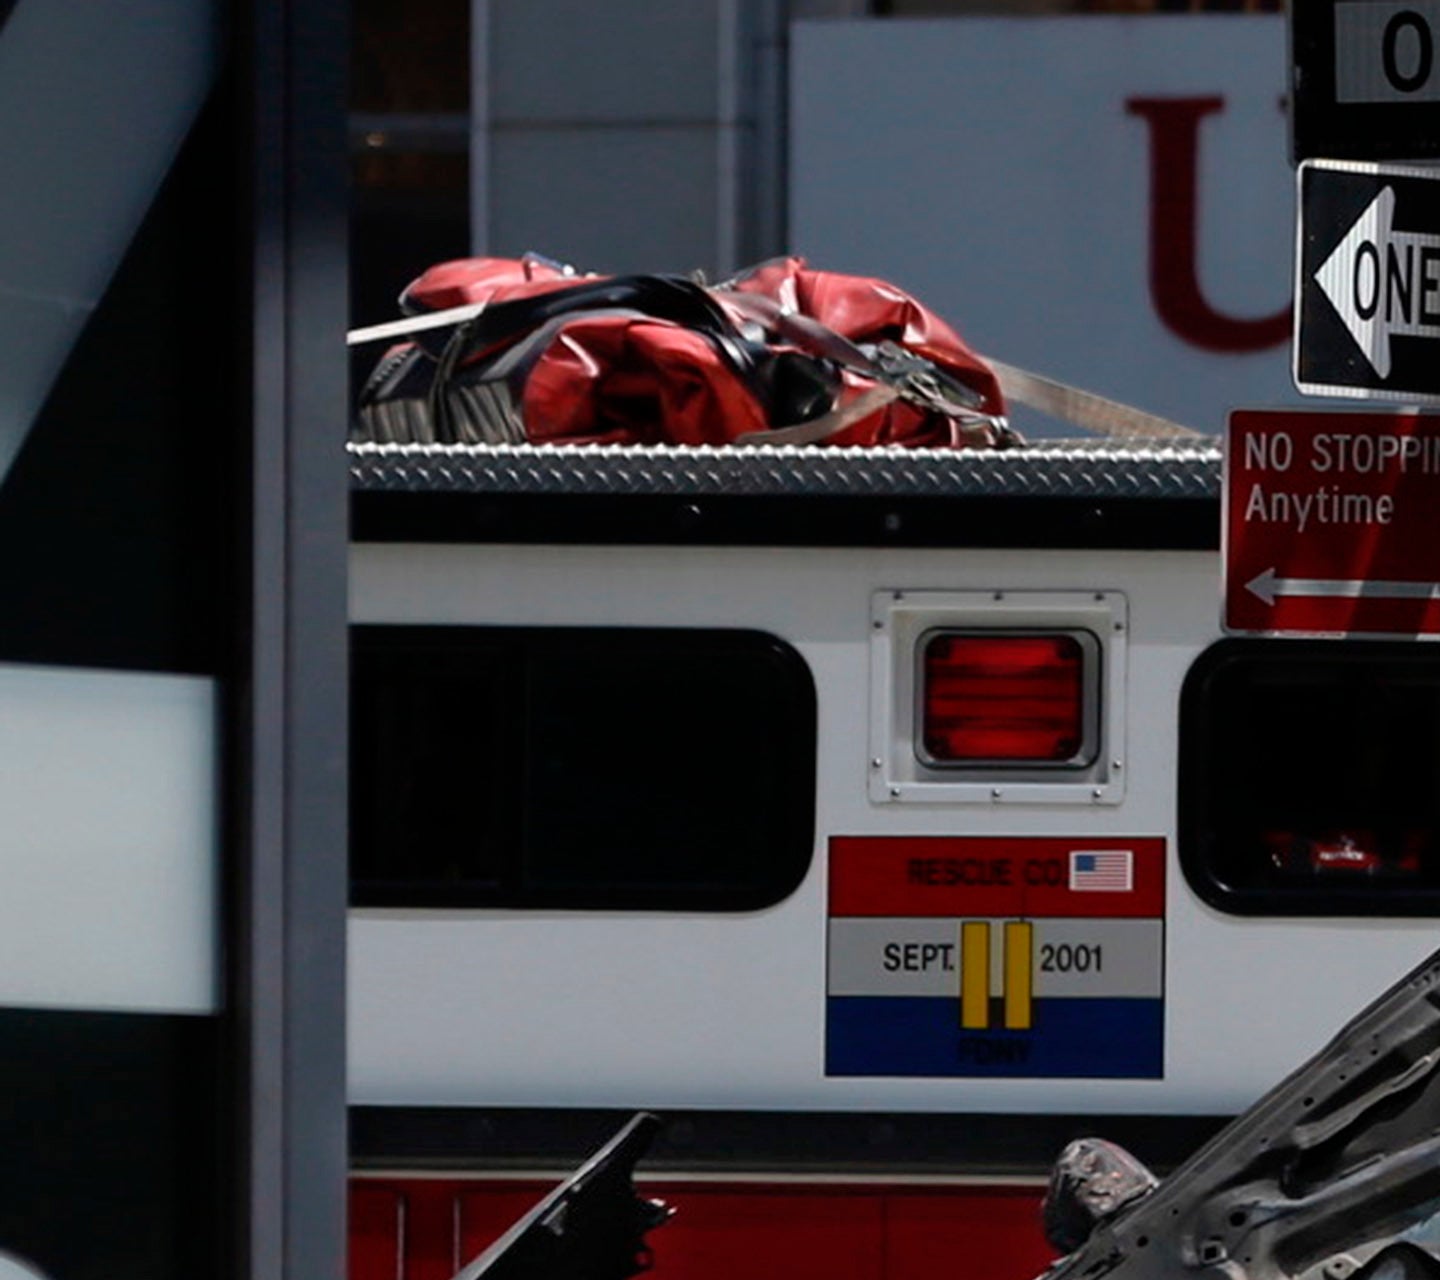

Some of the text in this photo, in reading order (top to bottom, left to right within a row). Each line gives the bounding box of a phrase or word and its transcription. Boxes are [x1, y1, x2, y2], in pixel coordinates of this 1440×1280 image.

[1245, 432, 1293, 471] NO
[1245, 483, 1394, 533] Anytime
[908, 858, 1013, 887] RESCUE
[883, 942, 955, 972] SEPT.
[1040, 943, 1102, 972] 2001
[957, 1037, 1032, 1067] FDNY
